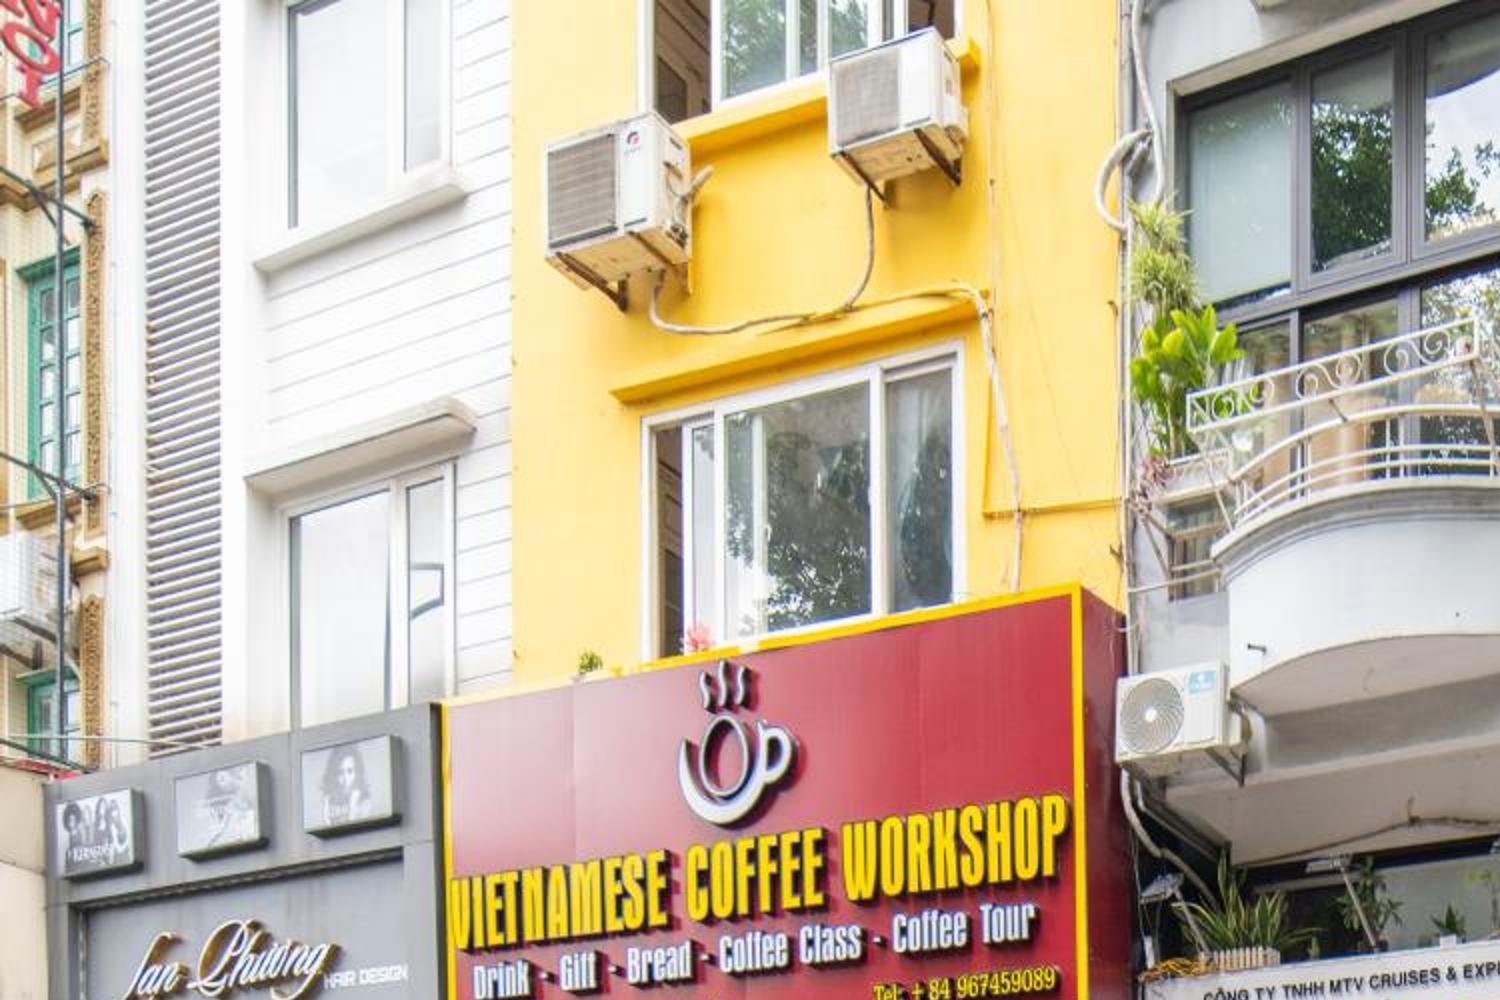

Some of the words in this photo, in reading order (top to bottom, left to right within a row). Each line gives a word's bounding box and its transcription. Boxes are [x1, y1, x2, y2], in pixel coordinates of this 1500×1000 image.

[451, 848, 669, 951] VIETNAMESE
[686, 826, 825, 923] COFFEE
[842, 794, 1068, 902] WORKSHOP
[473, 960, 532, 1000] Drink
[560, 951, 598, 991] Gift
[627, 941, 693, 984] Bread
[719, 930, 788, 973] Coffee
[799, 924, 865, 965] Class
[892, 907, 968, 953] Coffee
[979, 903, 1036, 944] Tour
[928, 979, 951, 1000] 84
[956, 966, 1056, 999] 967459089
[1328, 976, 1364, 997] MTV
[1369, 967, 1441, 993] CRUISES
[1446, 967, 1458, 983] &
